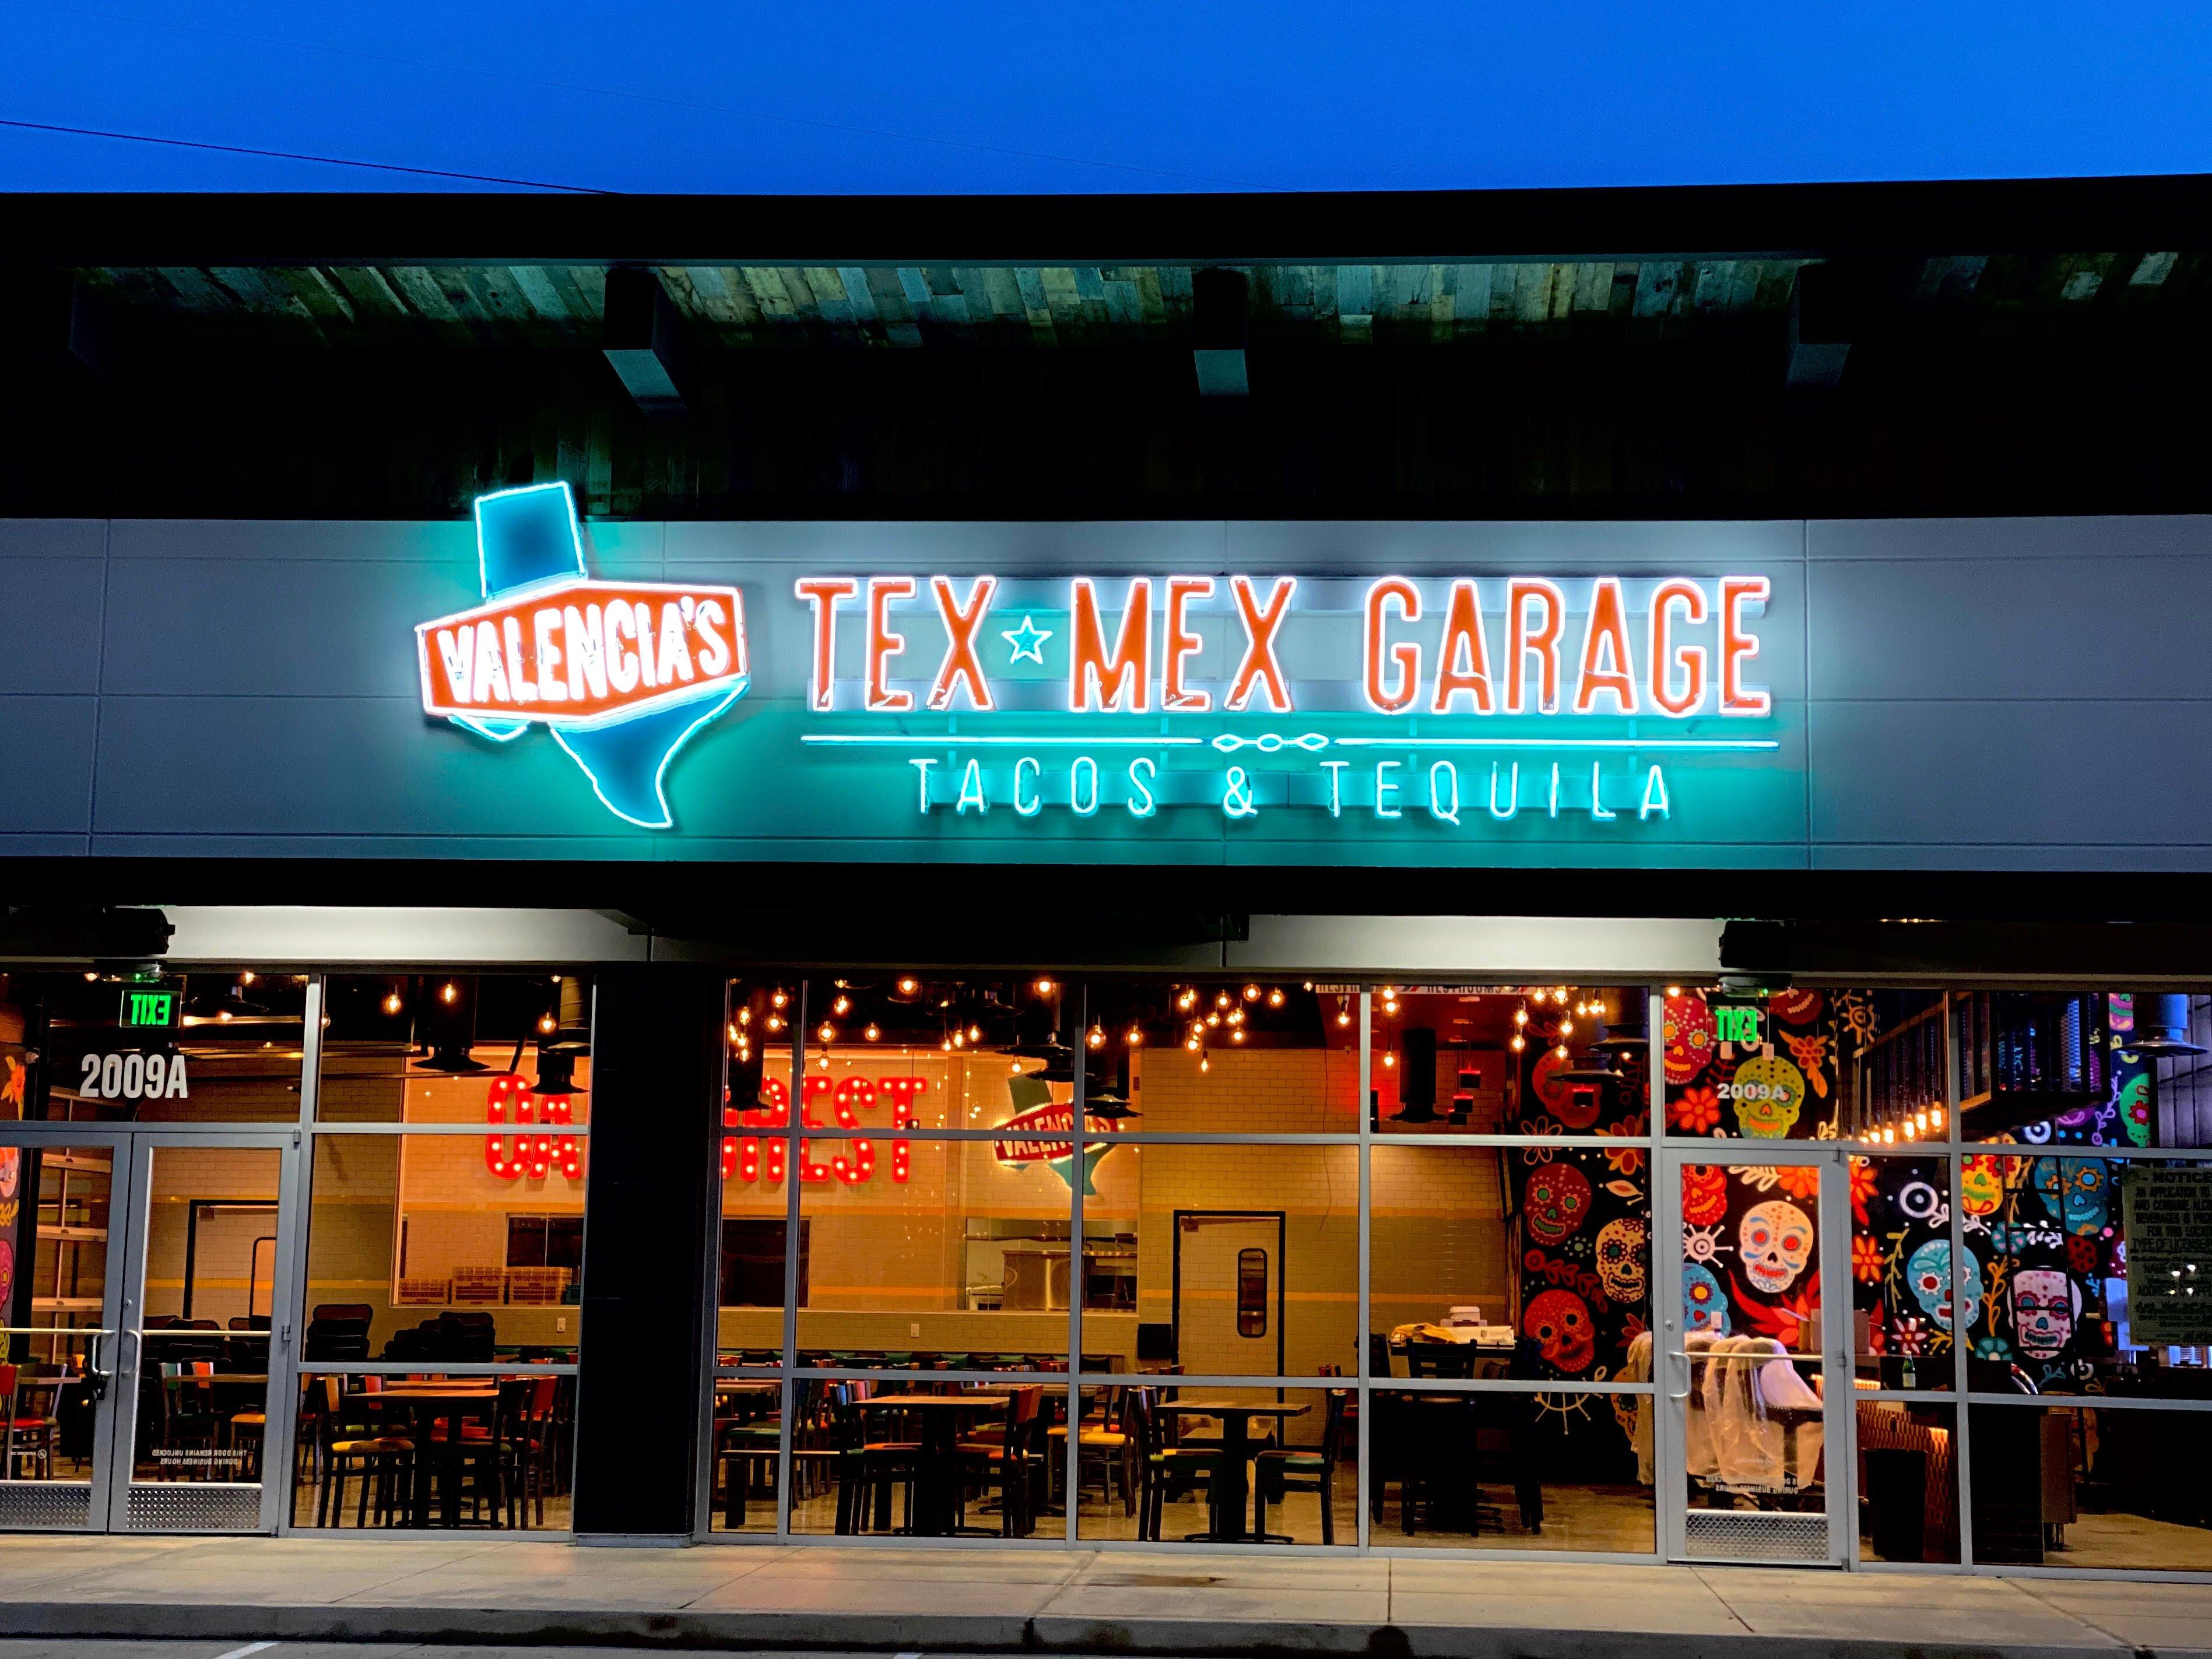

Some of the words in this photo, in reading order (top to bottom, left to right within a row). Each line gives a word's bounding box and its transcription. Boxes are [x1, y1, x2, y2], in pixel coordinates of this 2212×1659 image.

[437, 595, 731, 704] VALENCIA'S
[793, 575, 997, 712] TEX
[1068, 575, 1298, 713] MEX
[1362, 575, 1771, 717] GARAGE
[908, 756, 1157, 816] TACOS
[1223, 765, 1259, 817] &
[1319, 760, 1670, 825] TEQUILA
[79, 1053, 188, 1099] 2009A
[1717, 1083, 1785, 1100] 2009A
